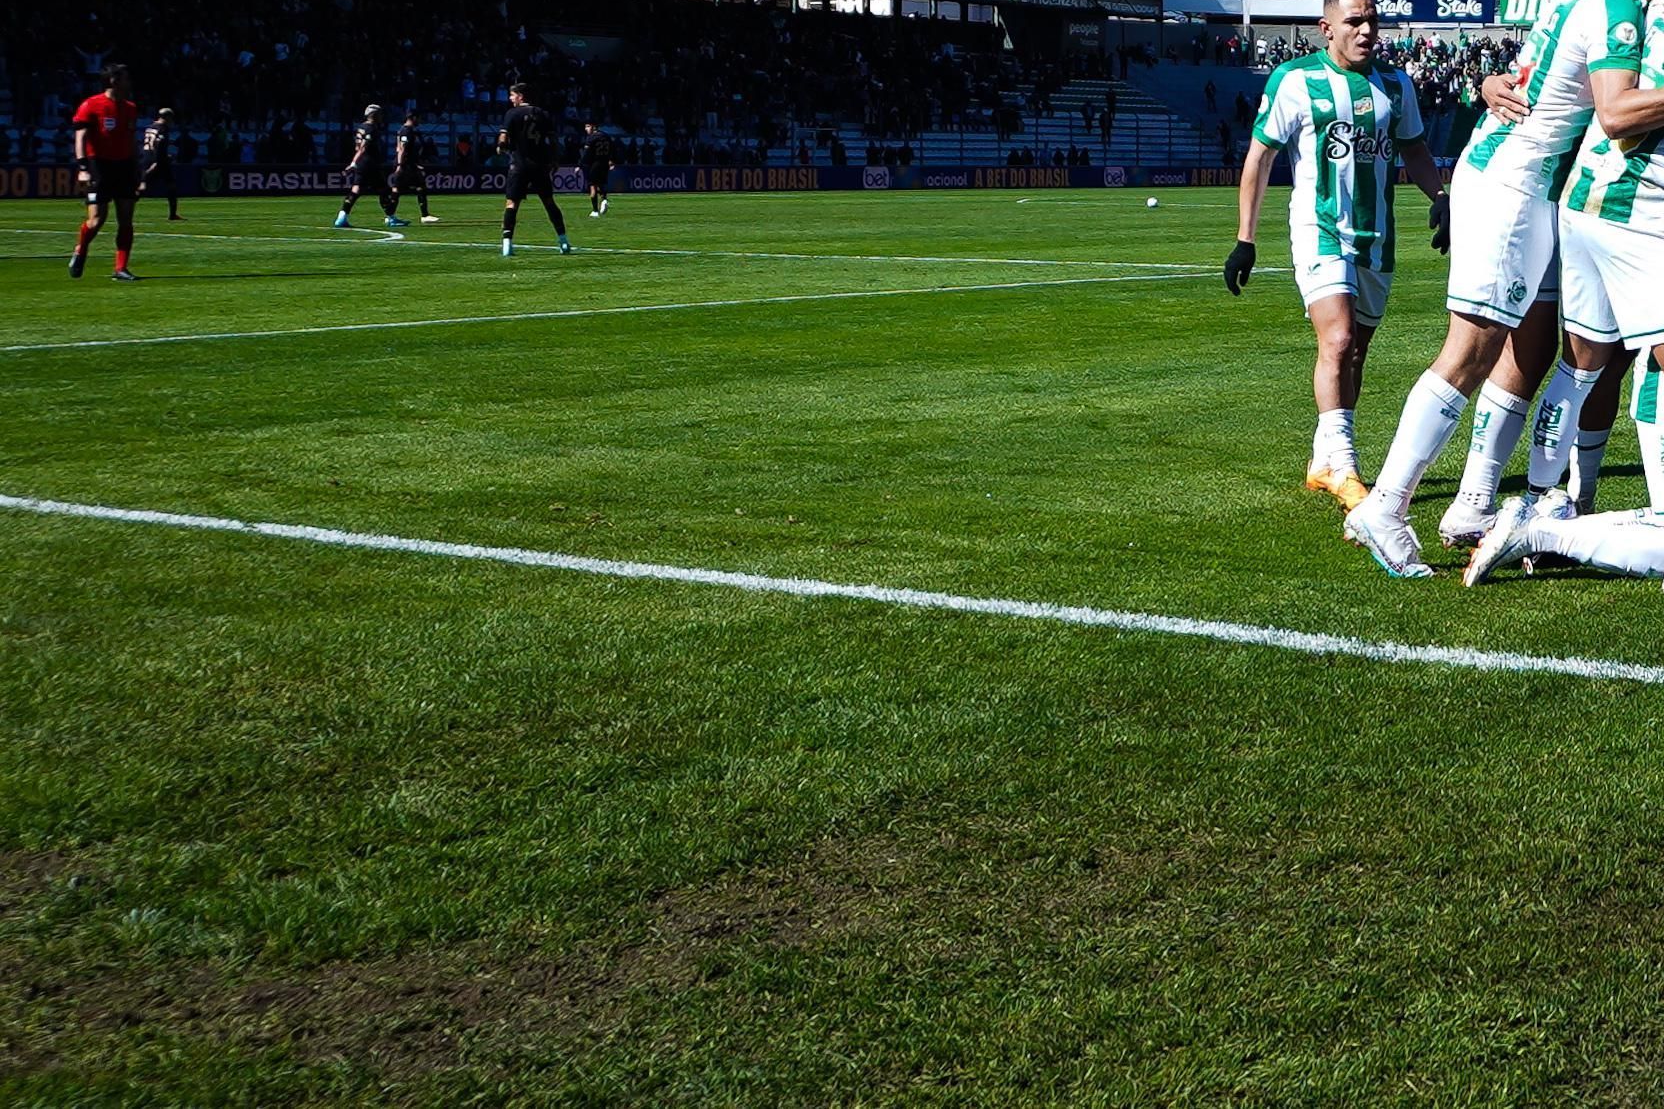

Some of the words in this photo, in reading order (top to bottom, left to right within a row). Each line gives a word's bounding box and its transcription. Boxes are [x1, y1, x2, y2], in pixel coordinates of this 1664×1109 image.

[1326, 120, 1393, 162] Stake
[767, 168, 820, 190] BRASIL
[1030, 168, 1070, 187] BRASIL
